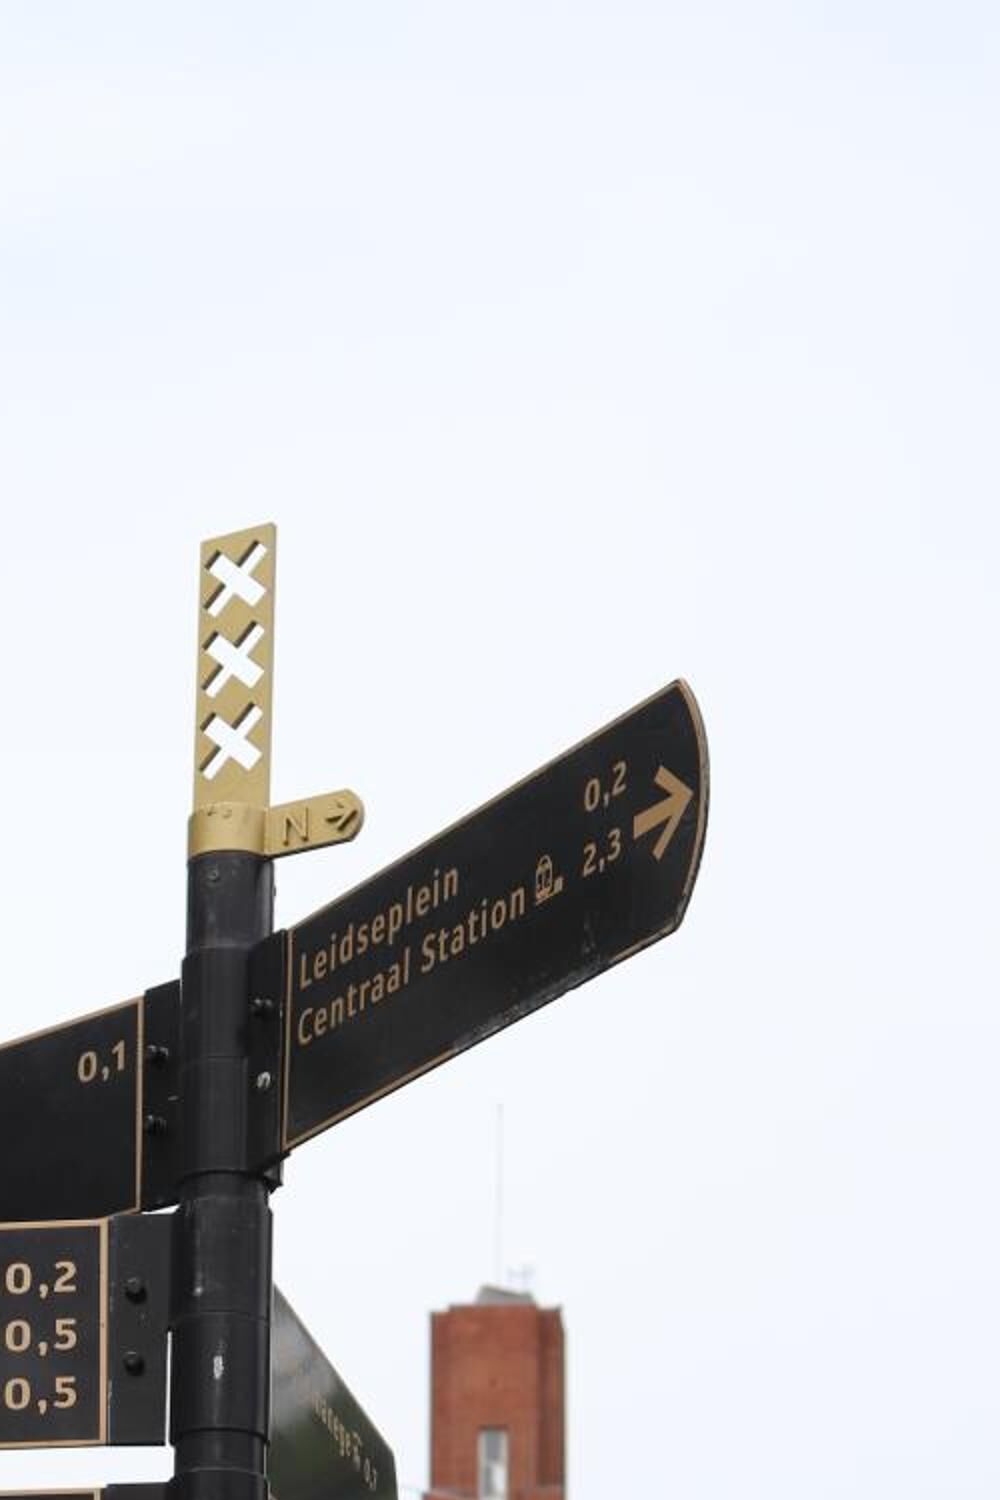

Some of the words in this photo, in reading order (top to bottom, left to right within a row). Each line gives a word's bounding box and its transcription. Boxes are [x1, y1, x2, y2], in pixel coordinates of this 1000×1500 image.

[282, 807, 310, 847] N
[300, 867, 459, 990] Leidseplein
[584, 760, 627, 812] 0,2
[298, 946, 411, 1046] Centraal
[421, 886, 525, 974] Station
[583, 828, 621, 877] 2,3
[77, 1039, 127, 1083] 0,1
[5, 1261, 77, 1299] 0,2
[5, 1318, 77, 1356] 0,5
[4, 1376, 77, 1414] 0,5
